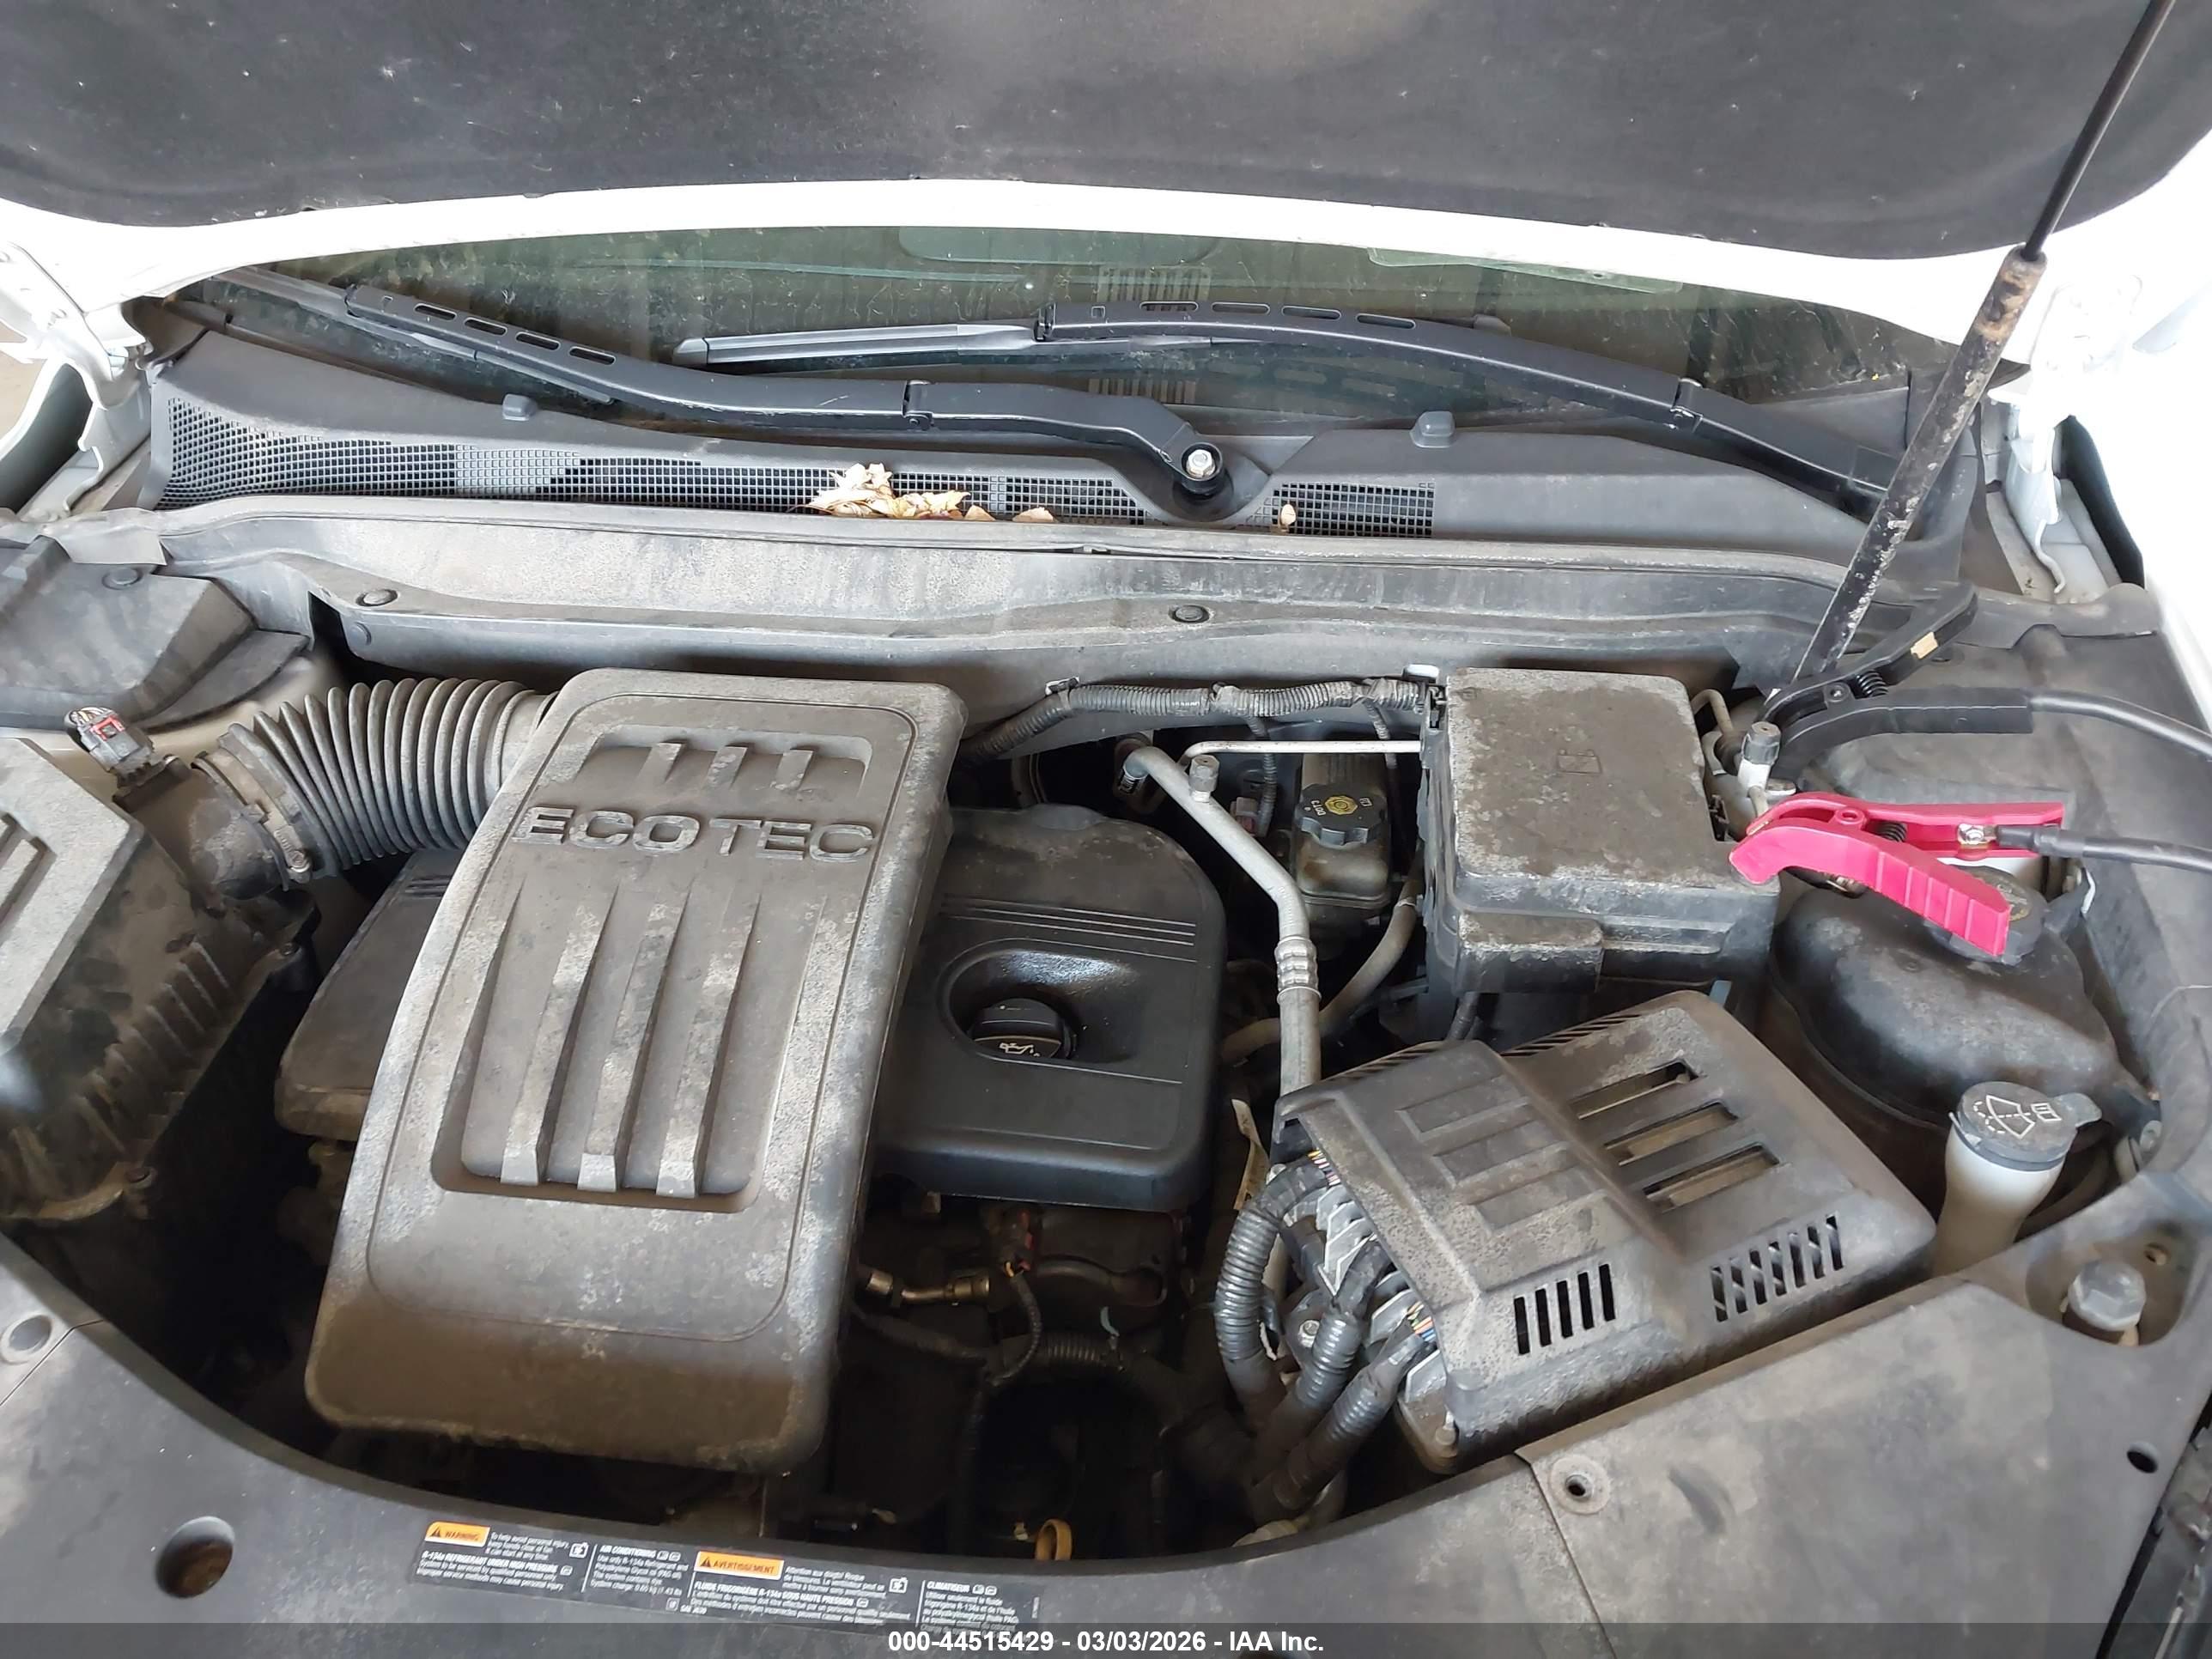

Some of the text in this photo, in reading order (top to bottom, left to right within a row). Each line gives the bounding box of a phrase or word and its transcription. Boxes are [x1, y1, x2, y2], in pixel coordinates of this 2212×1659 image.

[513, 806, 873, 862] ECOTEC
[611, 1546, 657, 1559] CONDITIONING
[525, 1560, 558, 1573] PRESSURE
[713, 1559, 775, 1575] AVERTISSEMENT
